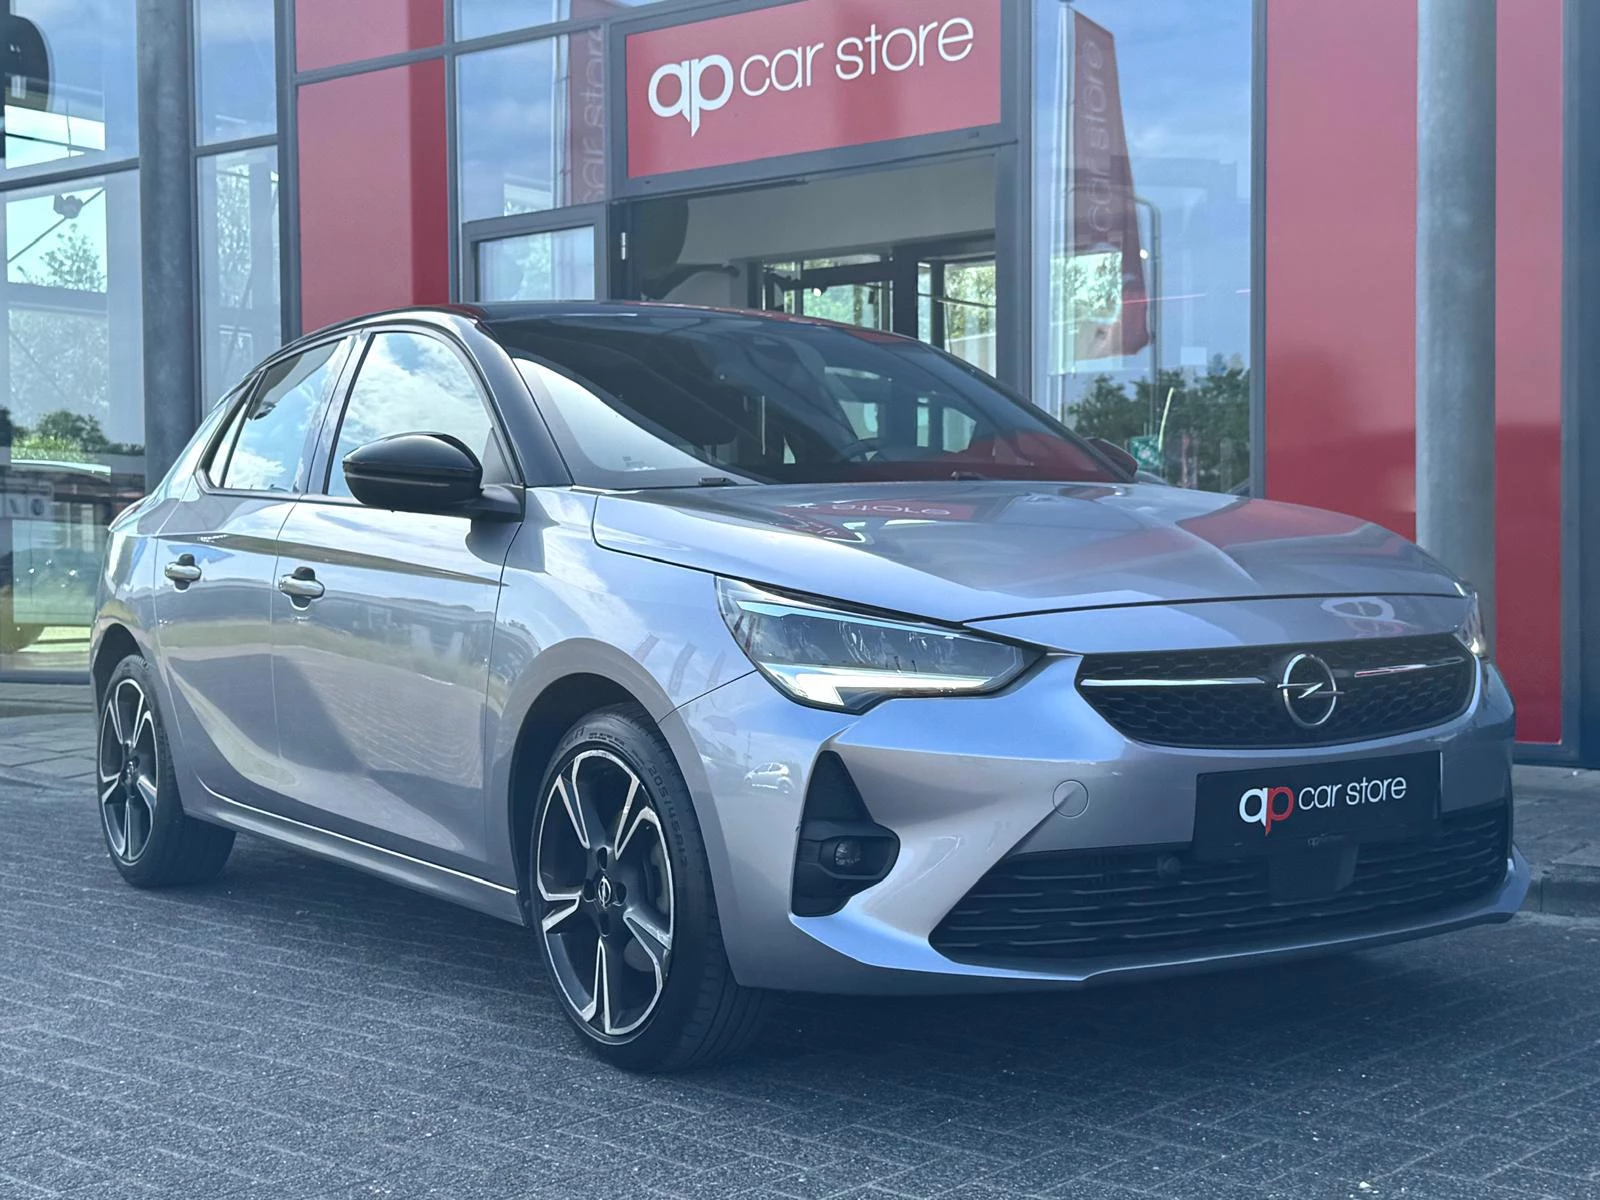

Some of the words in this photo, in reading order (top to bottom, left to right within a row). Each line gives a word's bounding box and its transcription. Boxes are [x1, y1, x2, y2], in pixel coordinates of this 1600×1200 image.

[648, 54, 734, 137] ap
[740, 42, 824, 96] car
[835, 17, 974, 80] store
[1239, 786, 1295, 836] ap
[1298, 784, 1342, 810] car
[1345, 776, 1407, 806] store
